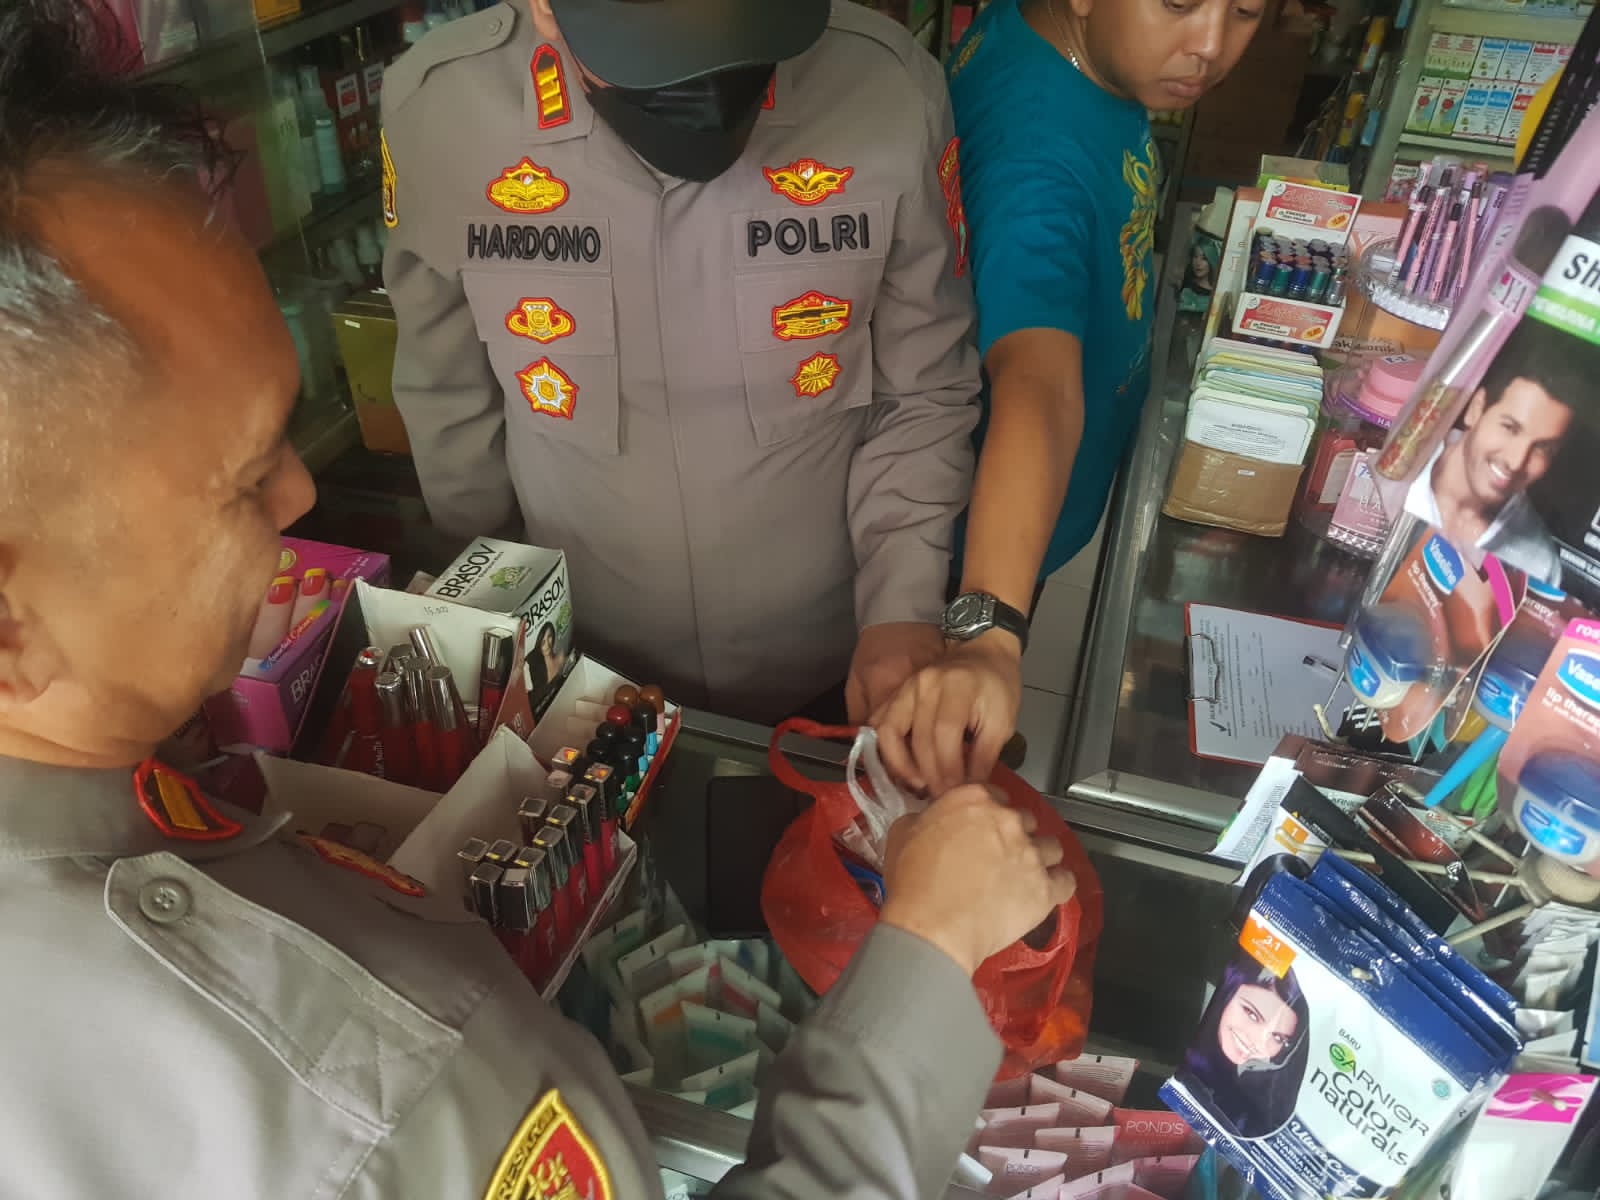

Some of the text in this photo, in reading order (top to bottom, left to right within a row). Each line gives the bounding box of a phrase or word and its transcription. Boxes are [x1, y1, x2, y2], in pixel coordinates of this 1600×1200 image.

[467, 223, 601, 263] HARDONO
[747, 212, 870, 257] POLRI
[436, 543, 497, 598] BRASOV
[1429, 536, 1457, 585] Vaseline
[521, 567, 566, 633] BRASOV
[1338, 1028, 1361, 1050] BARU
[1329, 1043, 1430, 1136] GARNIER
[1332, 1071, 1403, 1137] Color
[1126, 1120, 1185, 1135] POND'S
[1310, 1067, 1409, 1166] naturals
